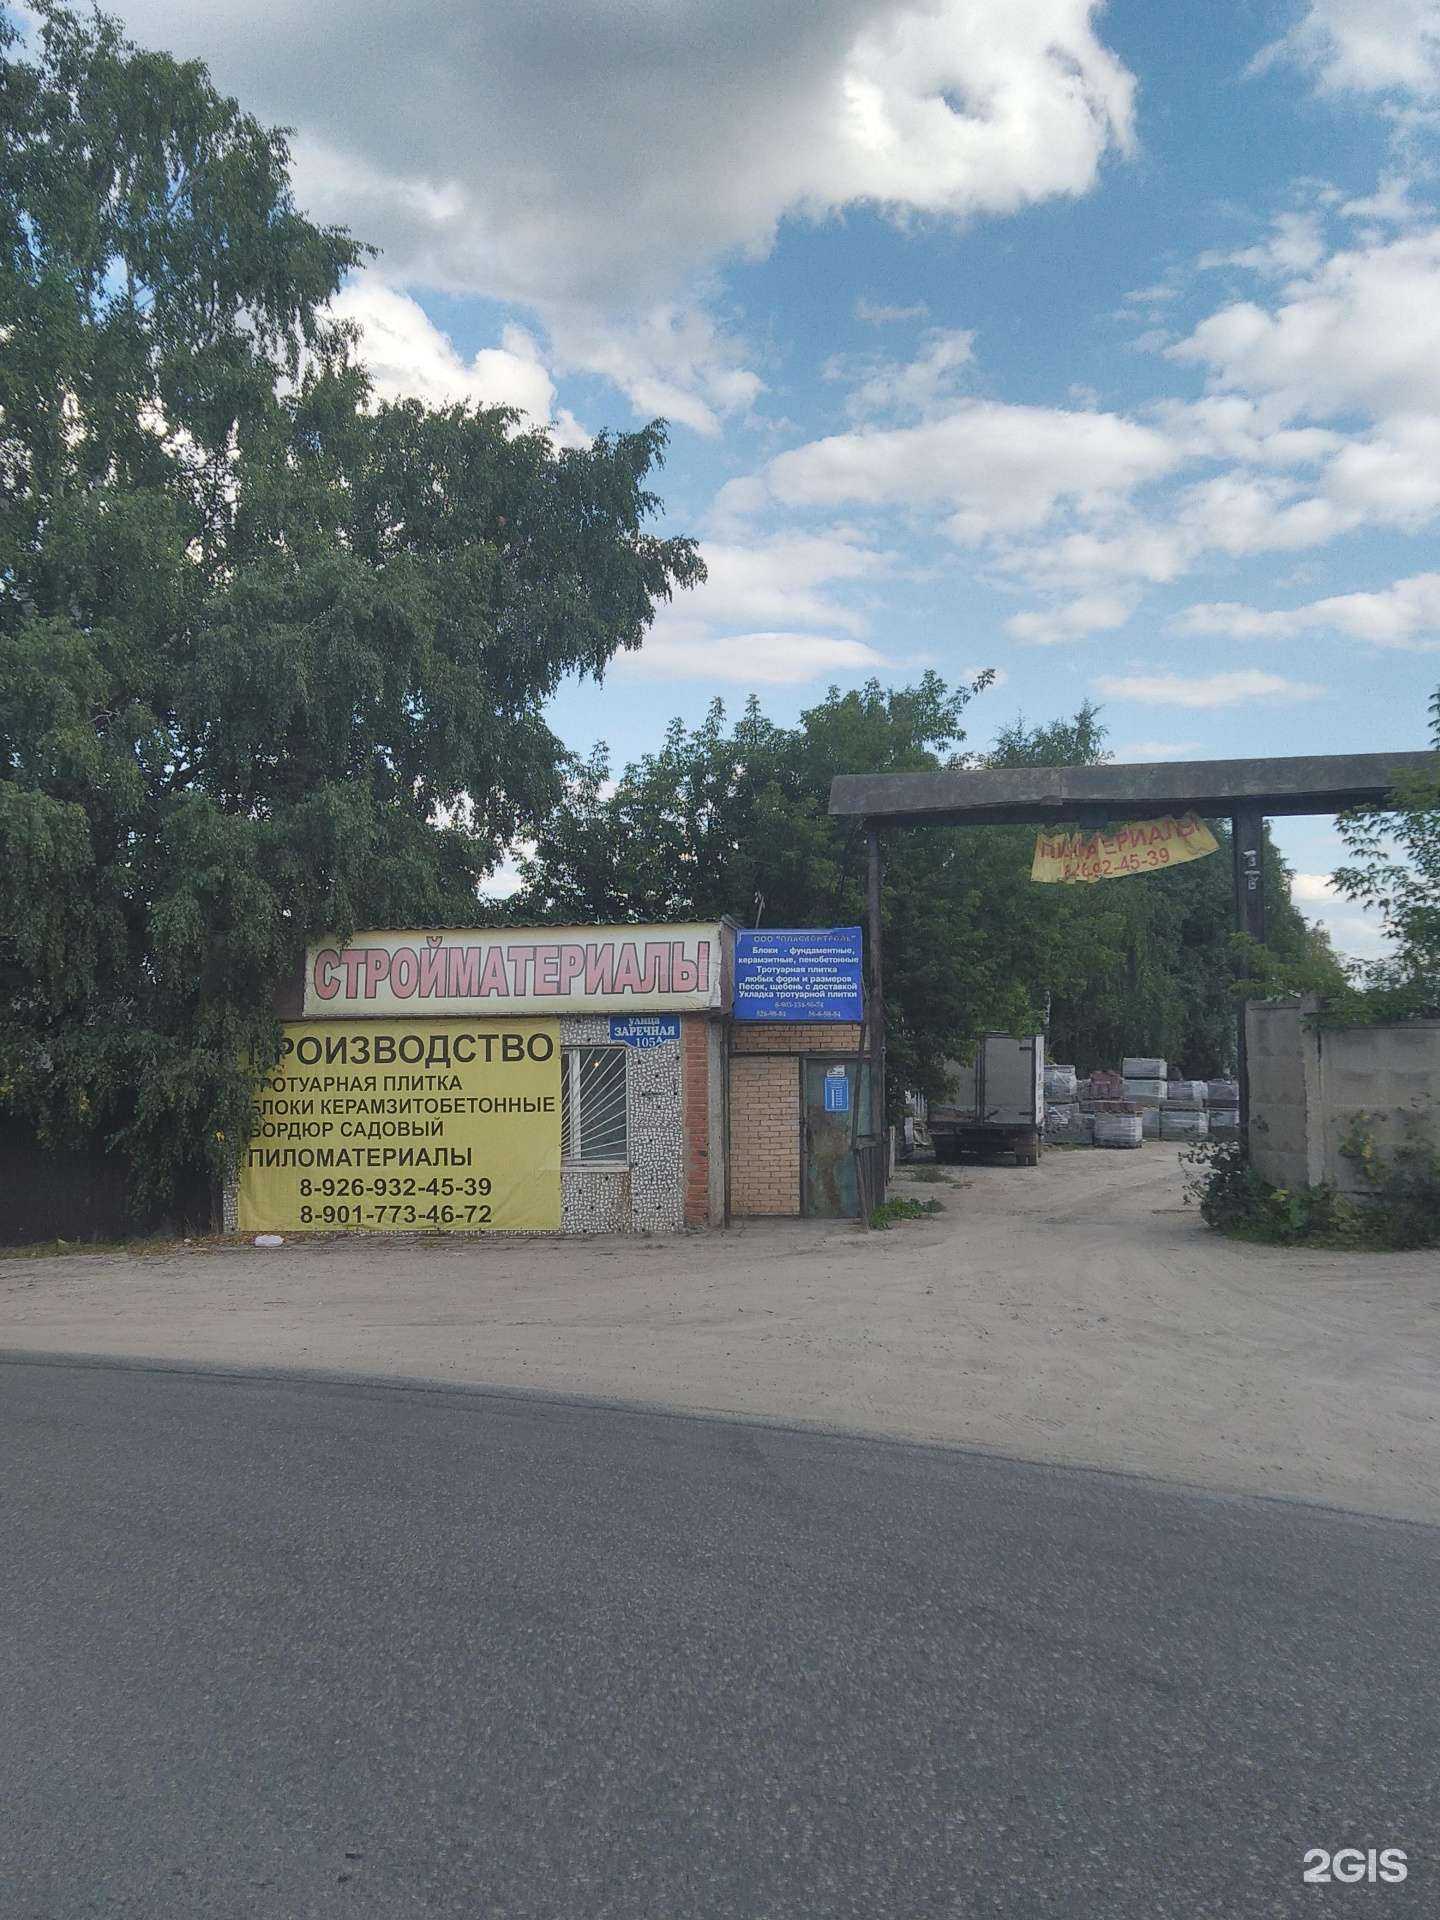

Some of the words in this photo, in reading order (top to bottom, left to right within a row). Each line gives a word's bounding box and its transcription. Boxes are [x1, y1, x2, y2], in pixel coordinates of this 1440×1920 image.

[753, 935, 774, 943] ООО
[752, 946, 778, 954] Блоки
[789, 946, 855, 956] фундаментные,
[799, 955, 859, 964] пенобетонные
[314, 936, 711, 1000] СТРОЙМАТЕРИАЛЫ
[756, 965, 806, 974] Тротуарная
[745, 974, 774, 983] любых
[775, 975, 800, 984] форм
[810, 975, 852, 984] размеров
[738, 983, 768, 991] Песок,
[770, 983, 803, 991] щебень
[812, 983, 858, 991] доставкой
[738, 991, 774, 999] Укладка
[776, 990, 825, 999] тротуарной
[827, 990, 857, 998] плитки
[628, 1017, 660, 1027] улица
[614, 1025, 676, 1036] ЗАРЕЧНАЯ
[636, 1036, 663, 1047] 105А
[383, 1075, 463, 1092] ПЛИТКА
[250, 1099, 314, 1115] БЛОКИ
[320, 1096, 556, 1115] КЕРАМЗИТОБЕТОННЫЕ
[250, 1121, 334, 1140] БОРДЮР
[340, 1116, 444, 1140] САДОВЫЙ
[248, 1147, 472, 1168] ПИЛОМАТЕРИАЛЫ
[300, 1177, 492, 1197] 8-926-932-45-39
[300, 1205, 492, 1224] 8-901-773-46-72
